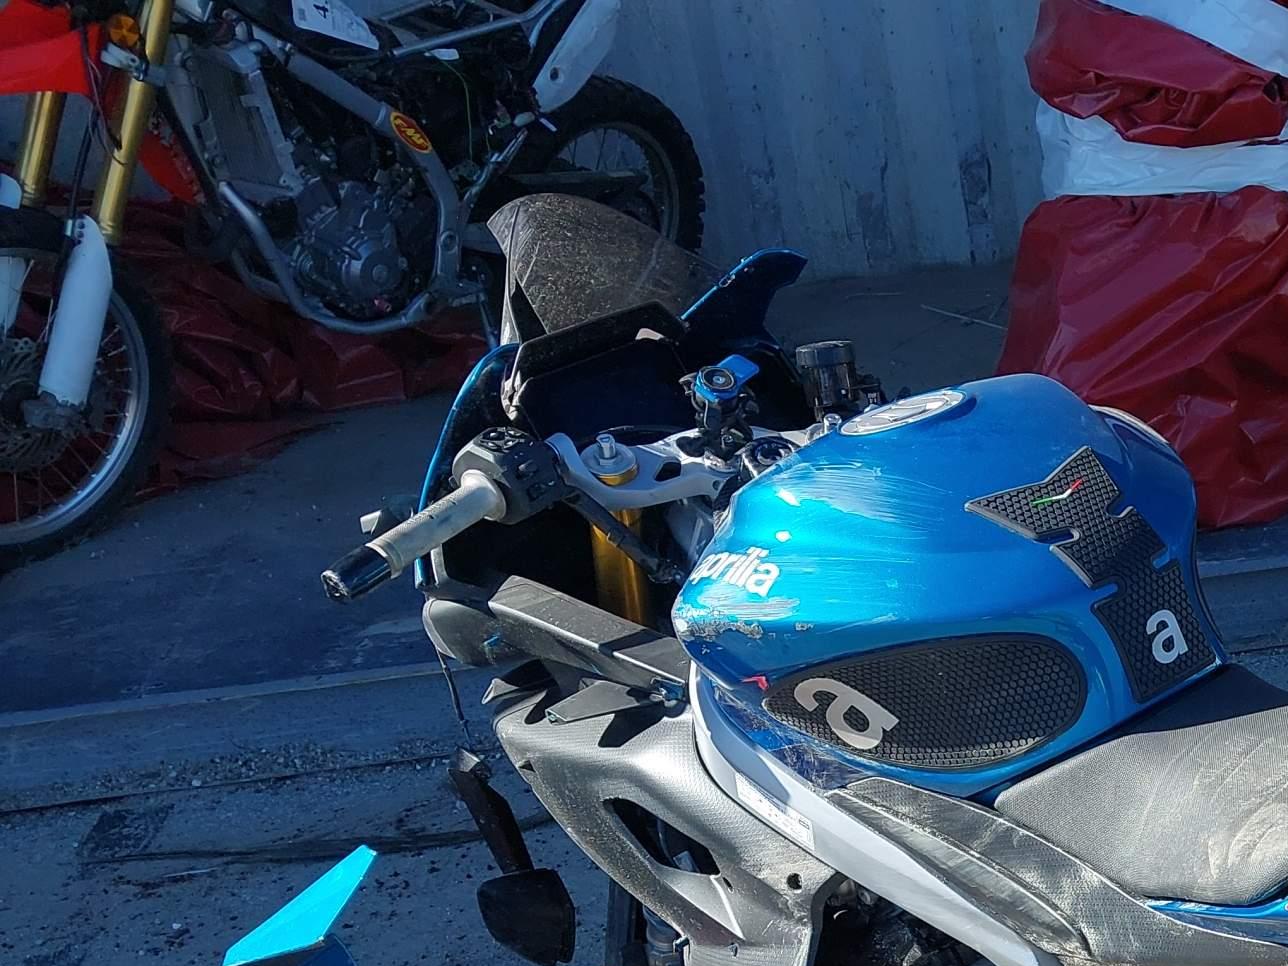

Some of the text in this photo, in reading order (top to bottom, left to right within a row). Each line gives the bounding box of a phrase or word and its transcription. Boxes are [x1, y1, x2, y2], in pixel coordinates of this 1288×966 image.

[689, 546, 781, 597] aprilia
[1146, 609, 1188, 664] a
[793, 678, 899, 750] a
